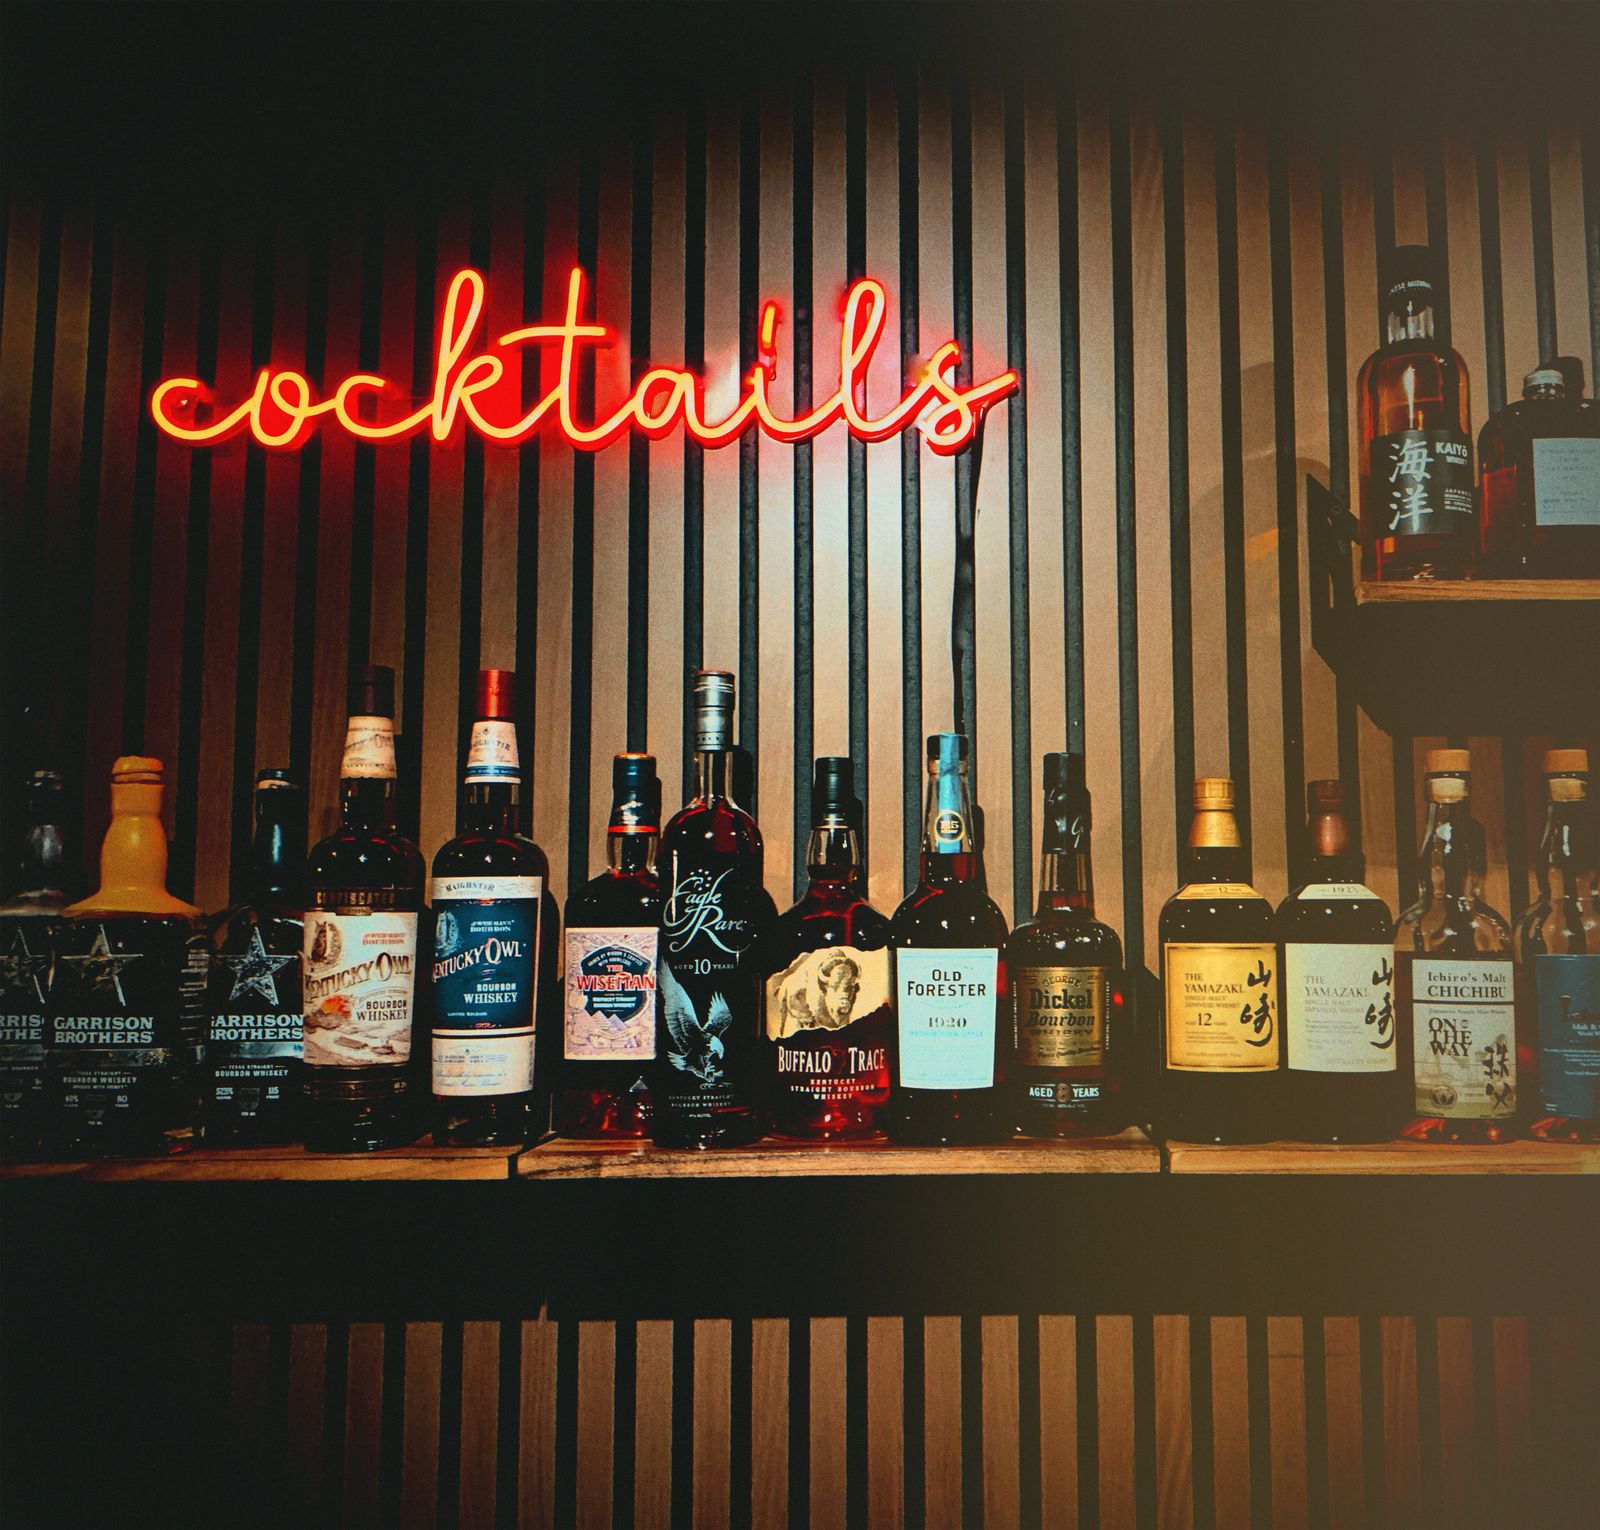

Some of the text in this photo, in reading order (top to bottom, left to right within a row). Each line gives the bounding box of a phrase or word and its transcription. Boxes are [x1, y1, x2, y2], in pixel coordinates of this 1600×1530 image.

[149, 266, 1020, 456] cocktails
[1389, 438, 1434, 533] 海洋
[668, 904, 753, 953] Rare
[484, 937, 523, 965] OWL
[694, 958, 711, 975] 10
[576, 972, 656, 991] WISEMAN
[932, 968, 962, 982] OLD
[1184, 972, 1204, 982] THE
[1304, 975, 1326, 984] THE
[1427, 971, 1478, 983] Ichiro's
[476, 983, 517, 993] BOURBON
[907, 980, 987, 997] FORESTER
[1427, 985, 1506, 998] CHICHIBU
[366, 999, 408, 1010] BOURBON
[463, 992, 519, 1004] WHISKEY
[1028, 988, 1094, 1010] Dickel
[356, 1008, 408, 1022] WHISKEY
[1025, 1012, 1096, 1027] Bourbon
[1197, 1012, 1213, 1026] 12
[53, 1016, 154, 1030] GARRISON
[928, 1017, 968, 1028] 1920
[1428, 1017, 1457, 1031] ON
[54, 1031, 154, 1043] BROTHERS
[1429, 1030, 1472, 1045] THE
[1430, 1041, 1470, 1057] WAY
[778, 1045, 886, 1075] BUFFALO TRACE
[790, 1084, 876, 1093] STRAIGHT BOURBON
[809, 1078, 857, 1086] KENTUCKY
[1028, 1087, 1054, 1098] AGED
[1072, 1086, 1100, 1098] YEARS
